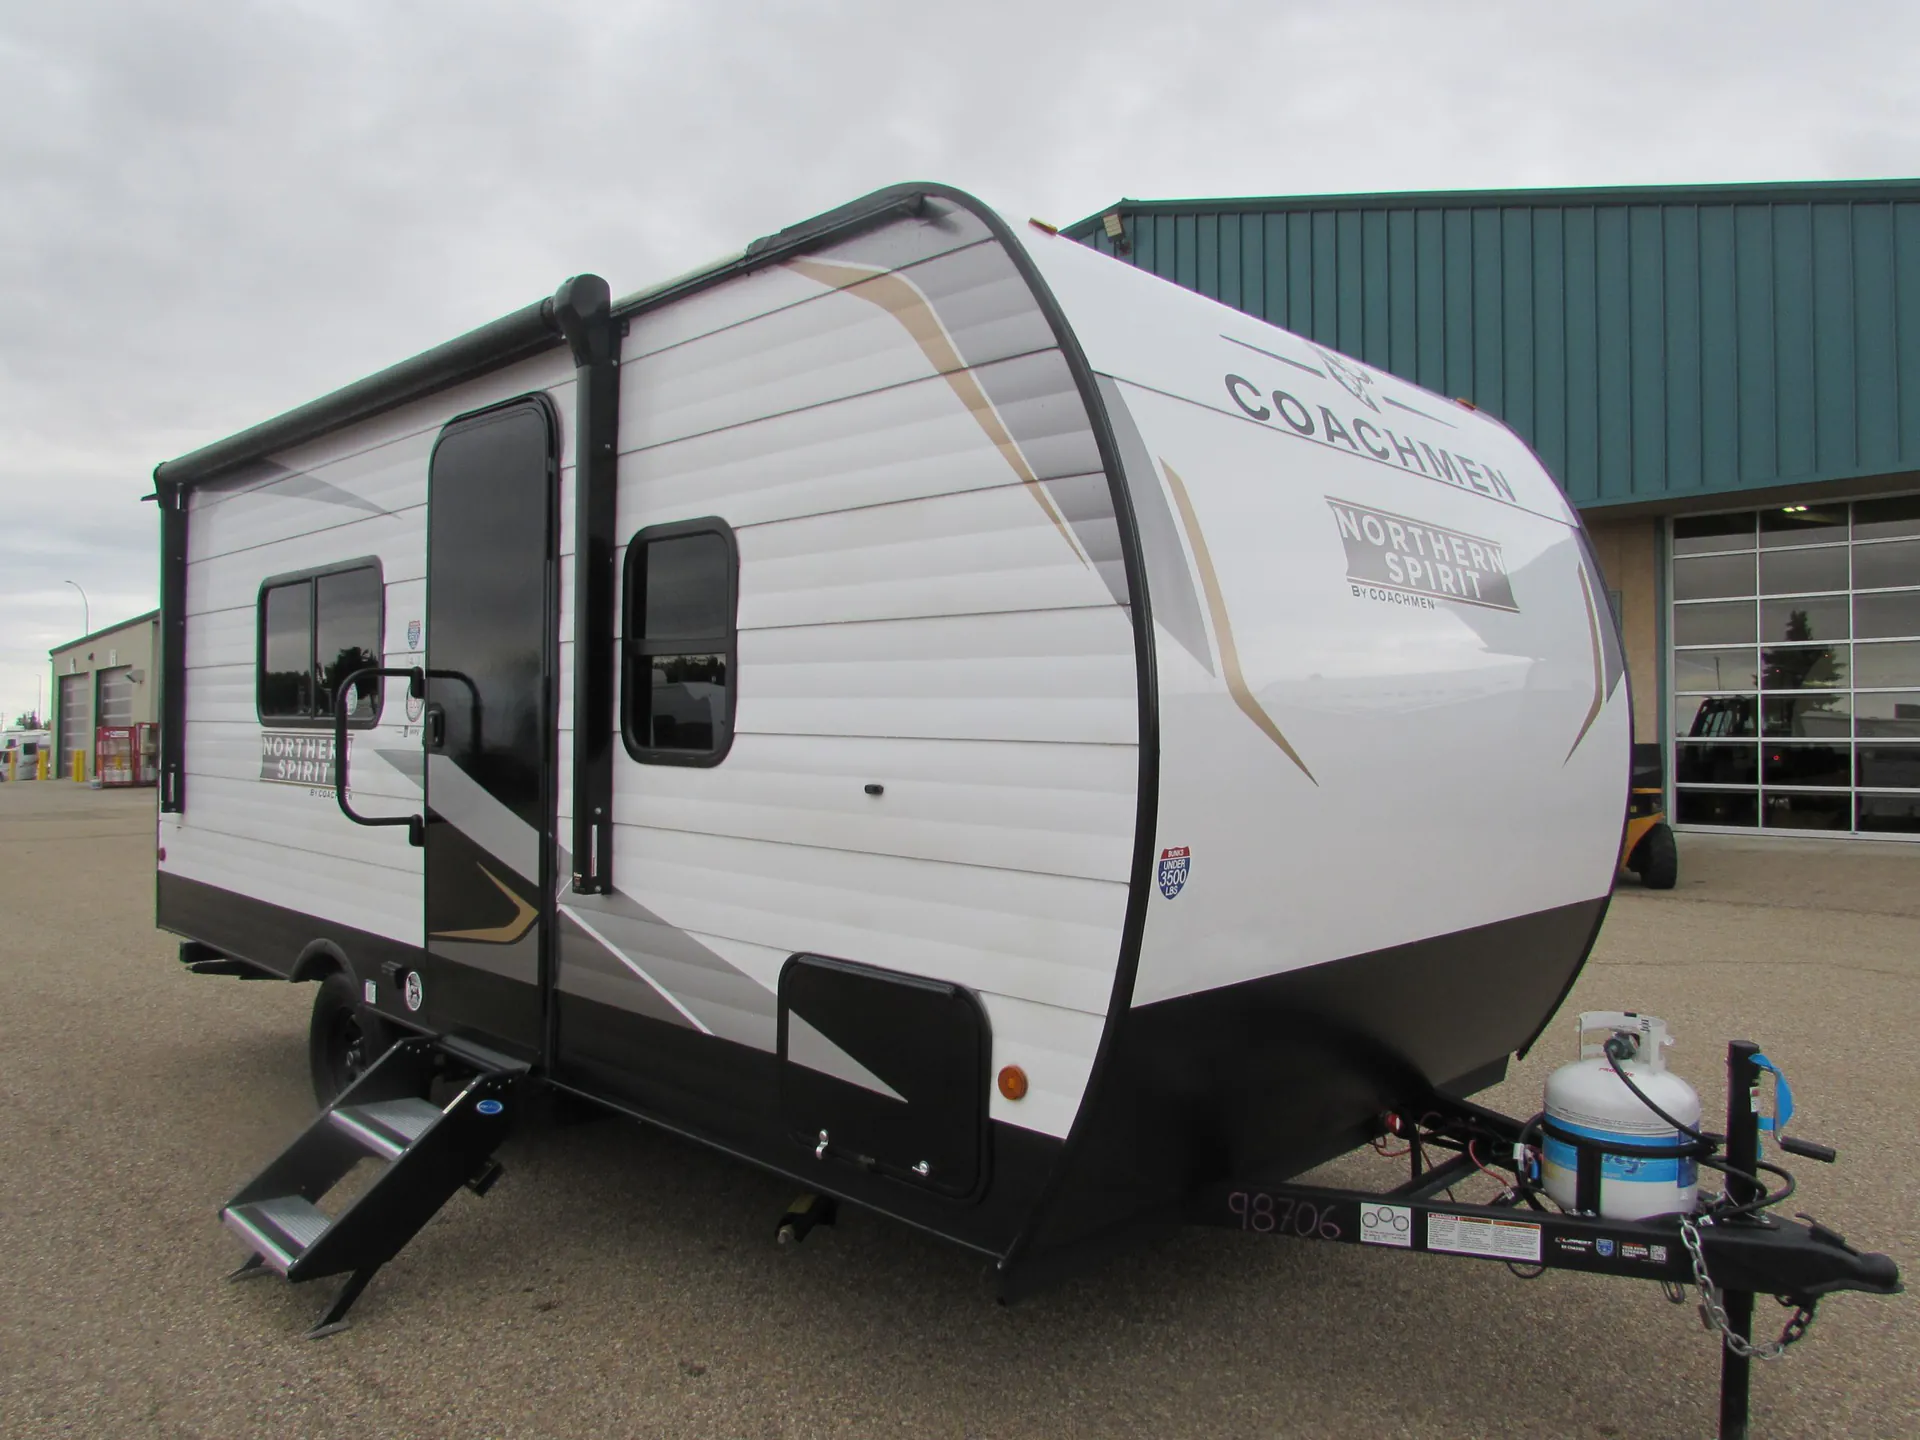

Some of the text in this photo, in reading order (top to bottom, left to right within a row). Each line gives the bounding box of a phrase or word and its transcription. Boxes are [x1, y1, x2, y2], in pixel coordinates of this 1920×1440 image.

[1224, 373, 1517, 503] COACHMEN
[1332, 505, 1507, 575] NORTHERN
[1385, 551, 1481, 601] SPIRIT
[1369, 588, 1435, 610] COACHMEN
[278, 759, 330, 783] SPIRIT
[1164, 859, 1186, 870] UNDER
[1160, 869, 1186, 886] 3500
[1165, 885, 1178, 896] LBS
[1228, 1191, 1342, 1240] 98706
